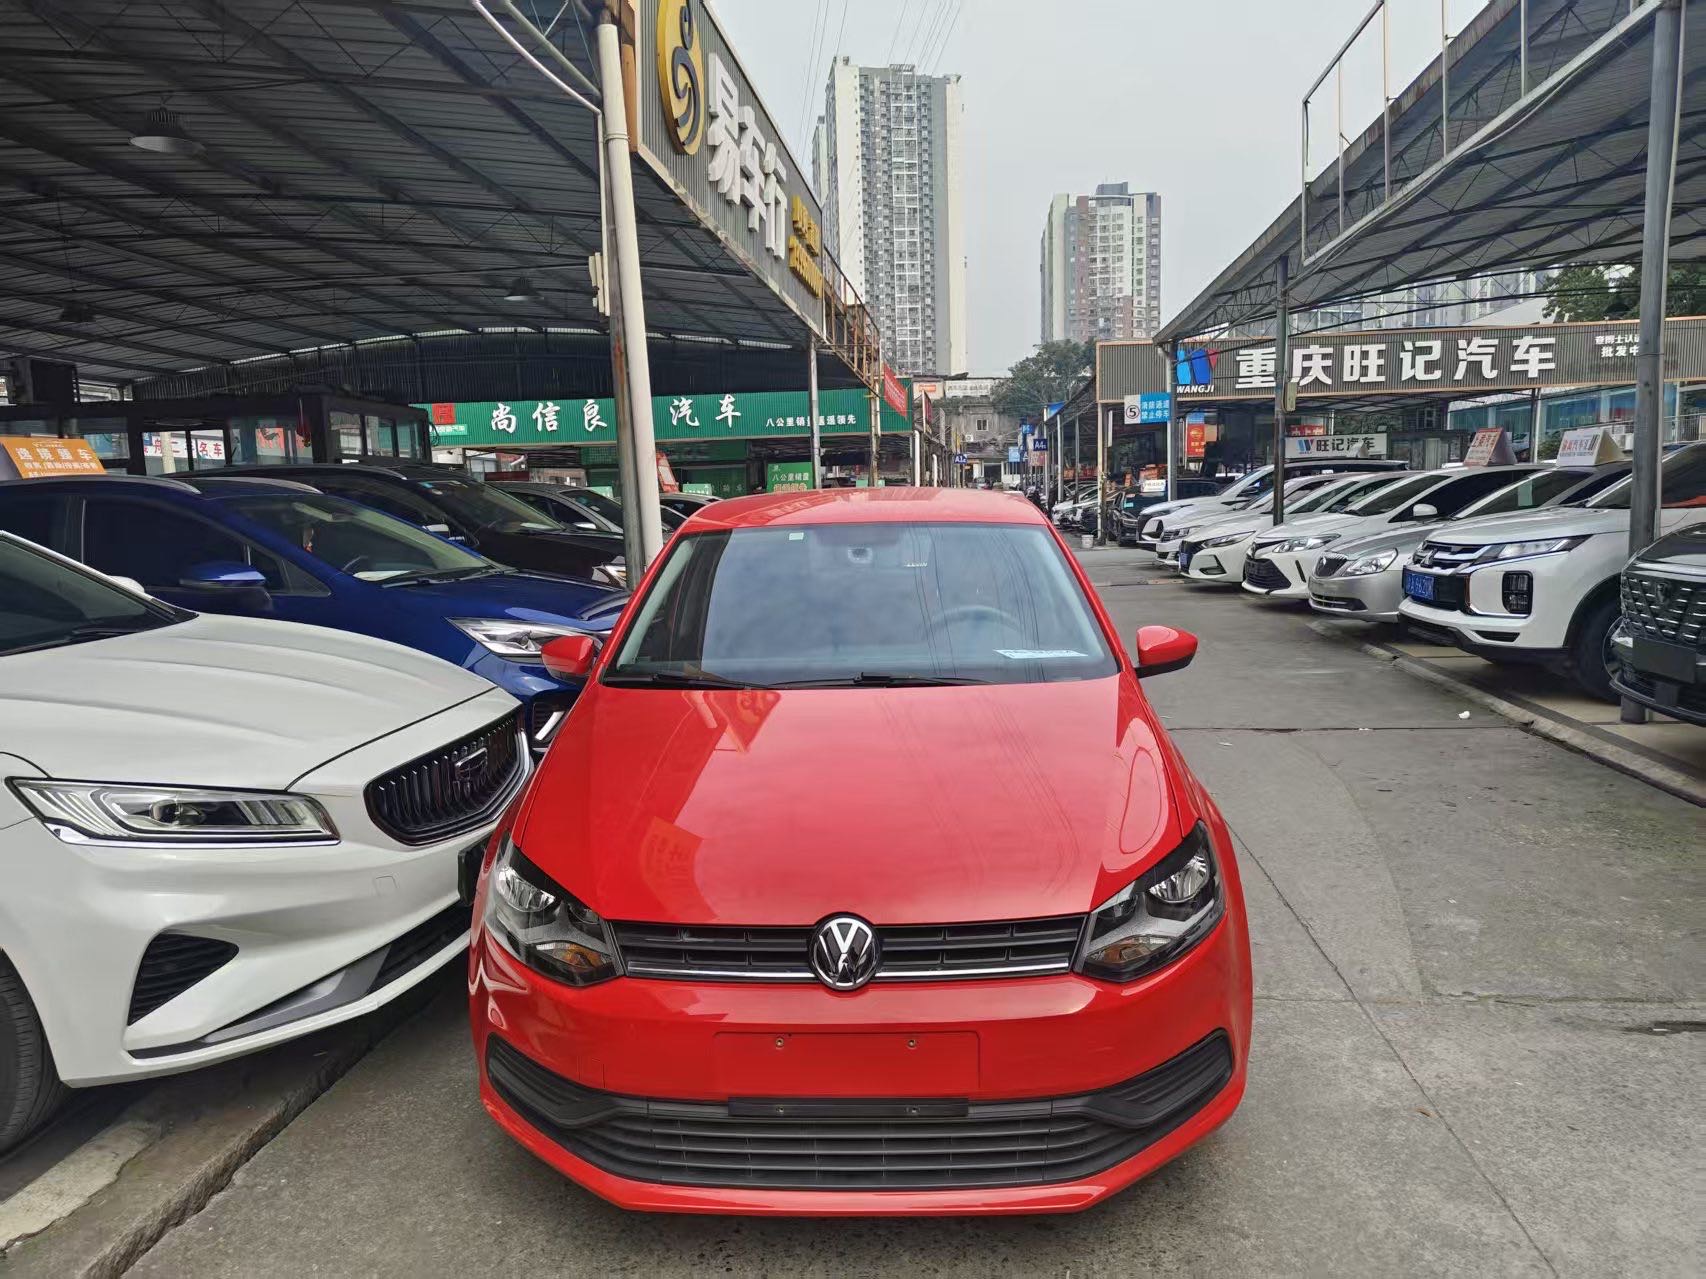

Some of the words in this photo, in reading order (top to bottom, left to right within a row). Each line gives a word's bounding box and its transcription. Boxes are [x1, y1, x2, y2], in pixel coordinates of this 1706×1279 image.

[1601, 345, 1640, 357] 批发中
[1236, 336, 1556, 388] 重庆旺记汽车
[1176, 385, 1214, 393] WANGJI
